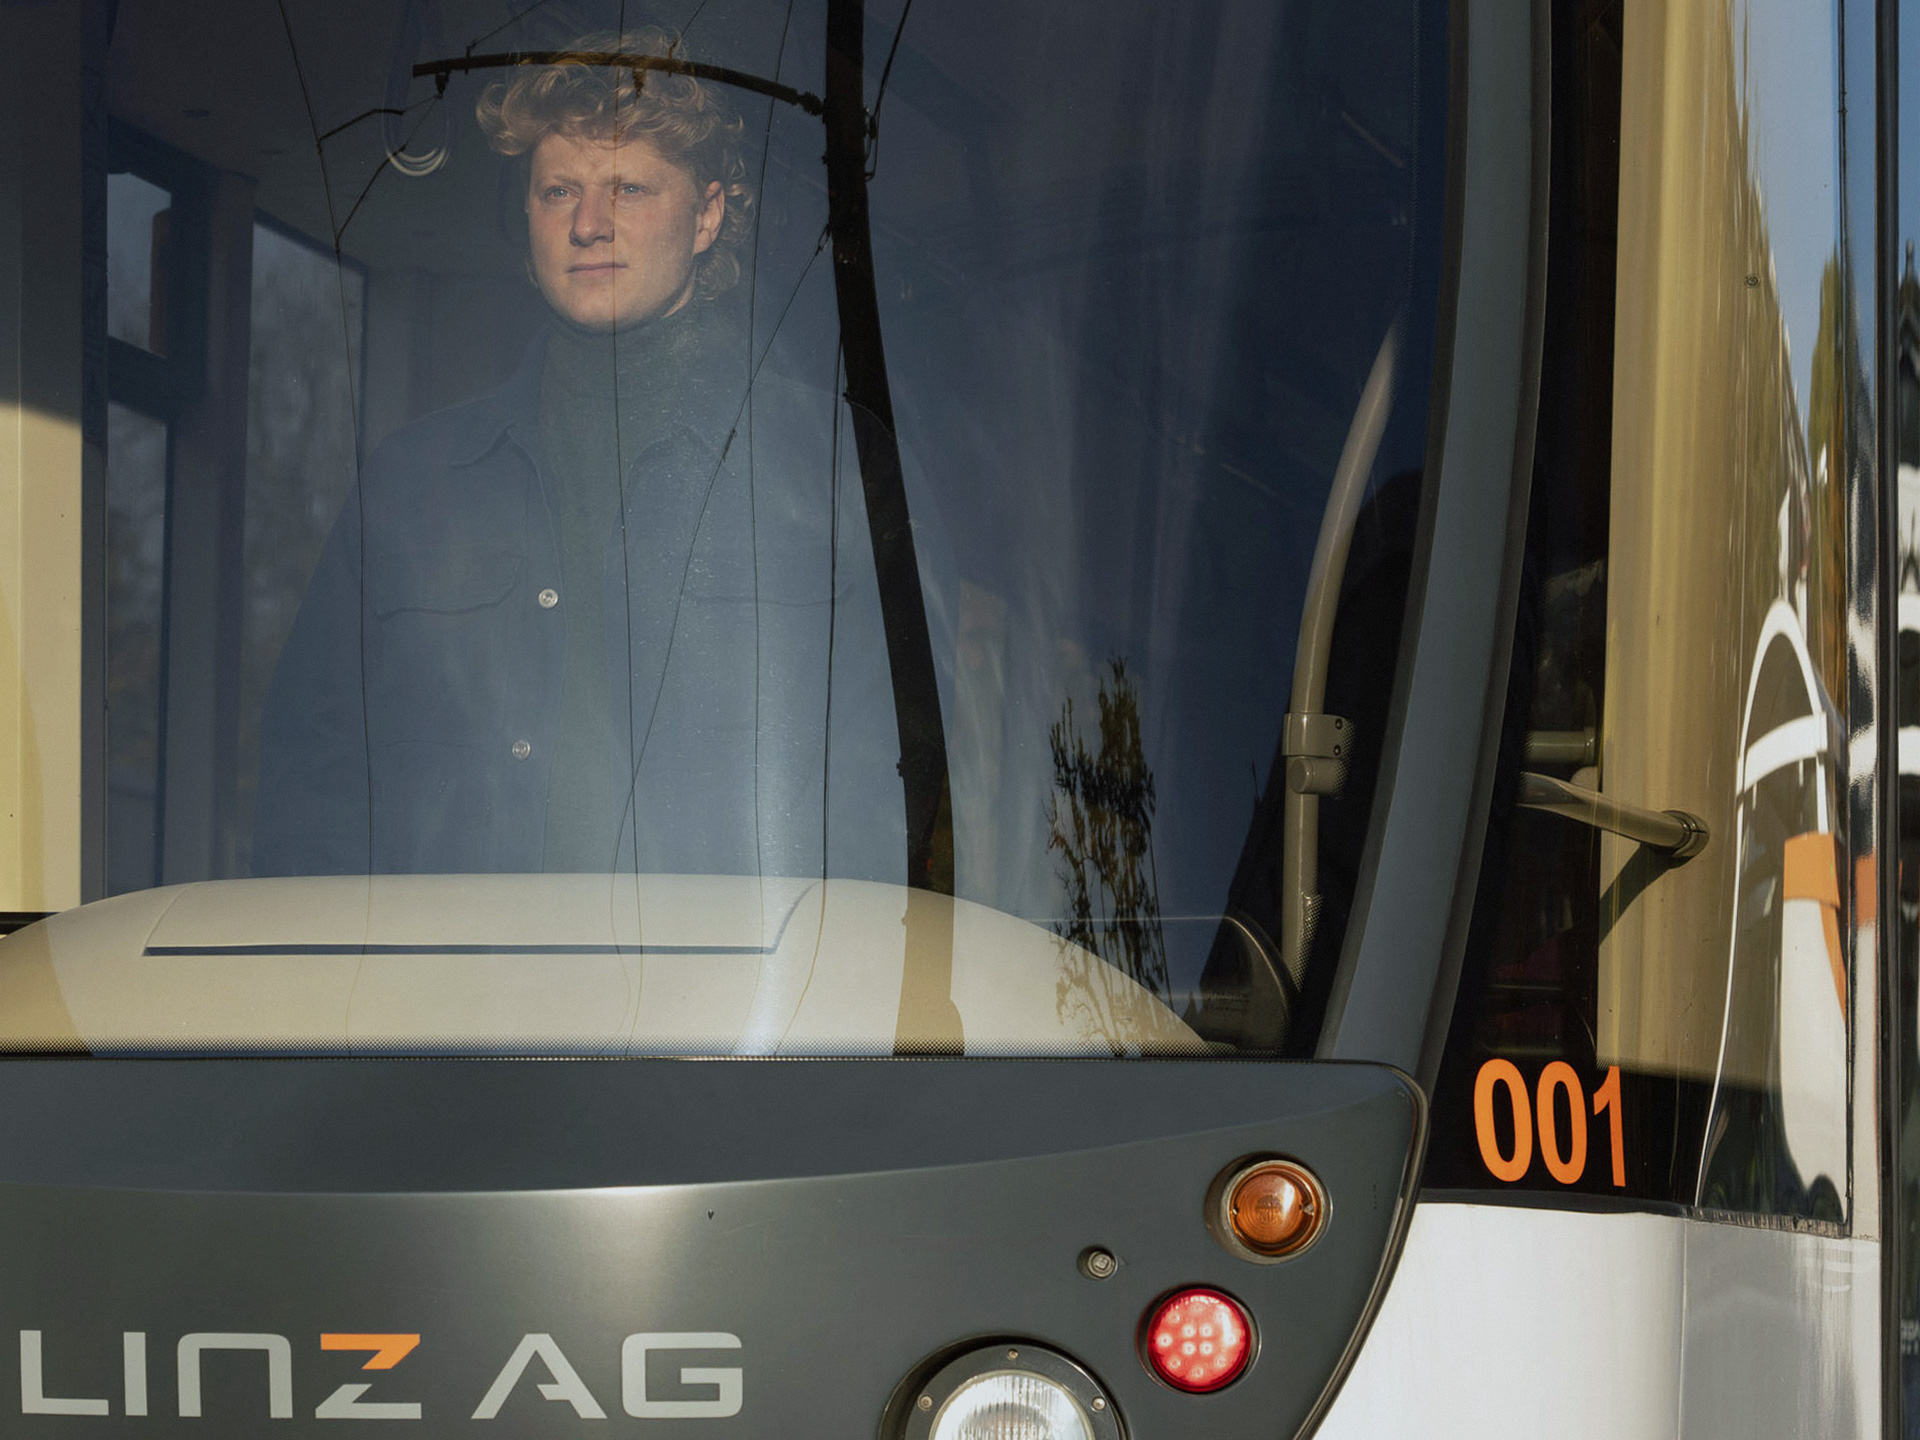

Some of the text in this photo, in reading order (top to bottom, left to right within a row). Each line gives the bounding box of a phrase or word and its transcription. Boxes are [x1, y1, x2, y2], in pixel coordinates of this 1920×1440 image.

[1473, 1058, 1626, 1187] 001
[20, 1330, 744, 1420] LINZ AG
